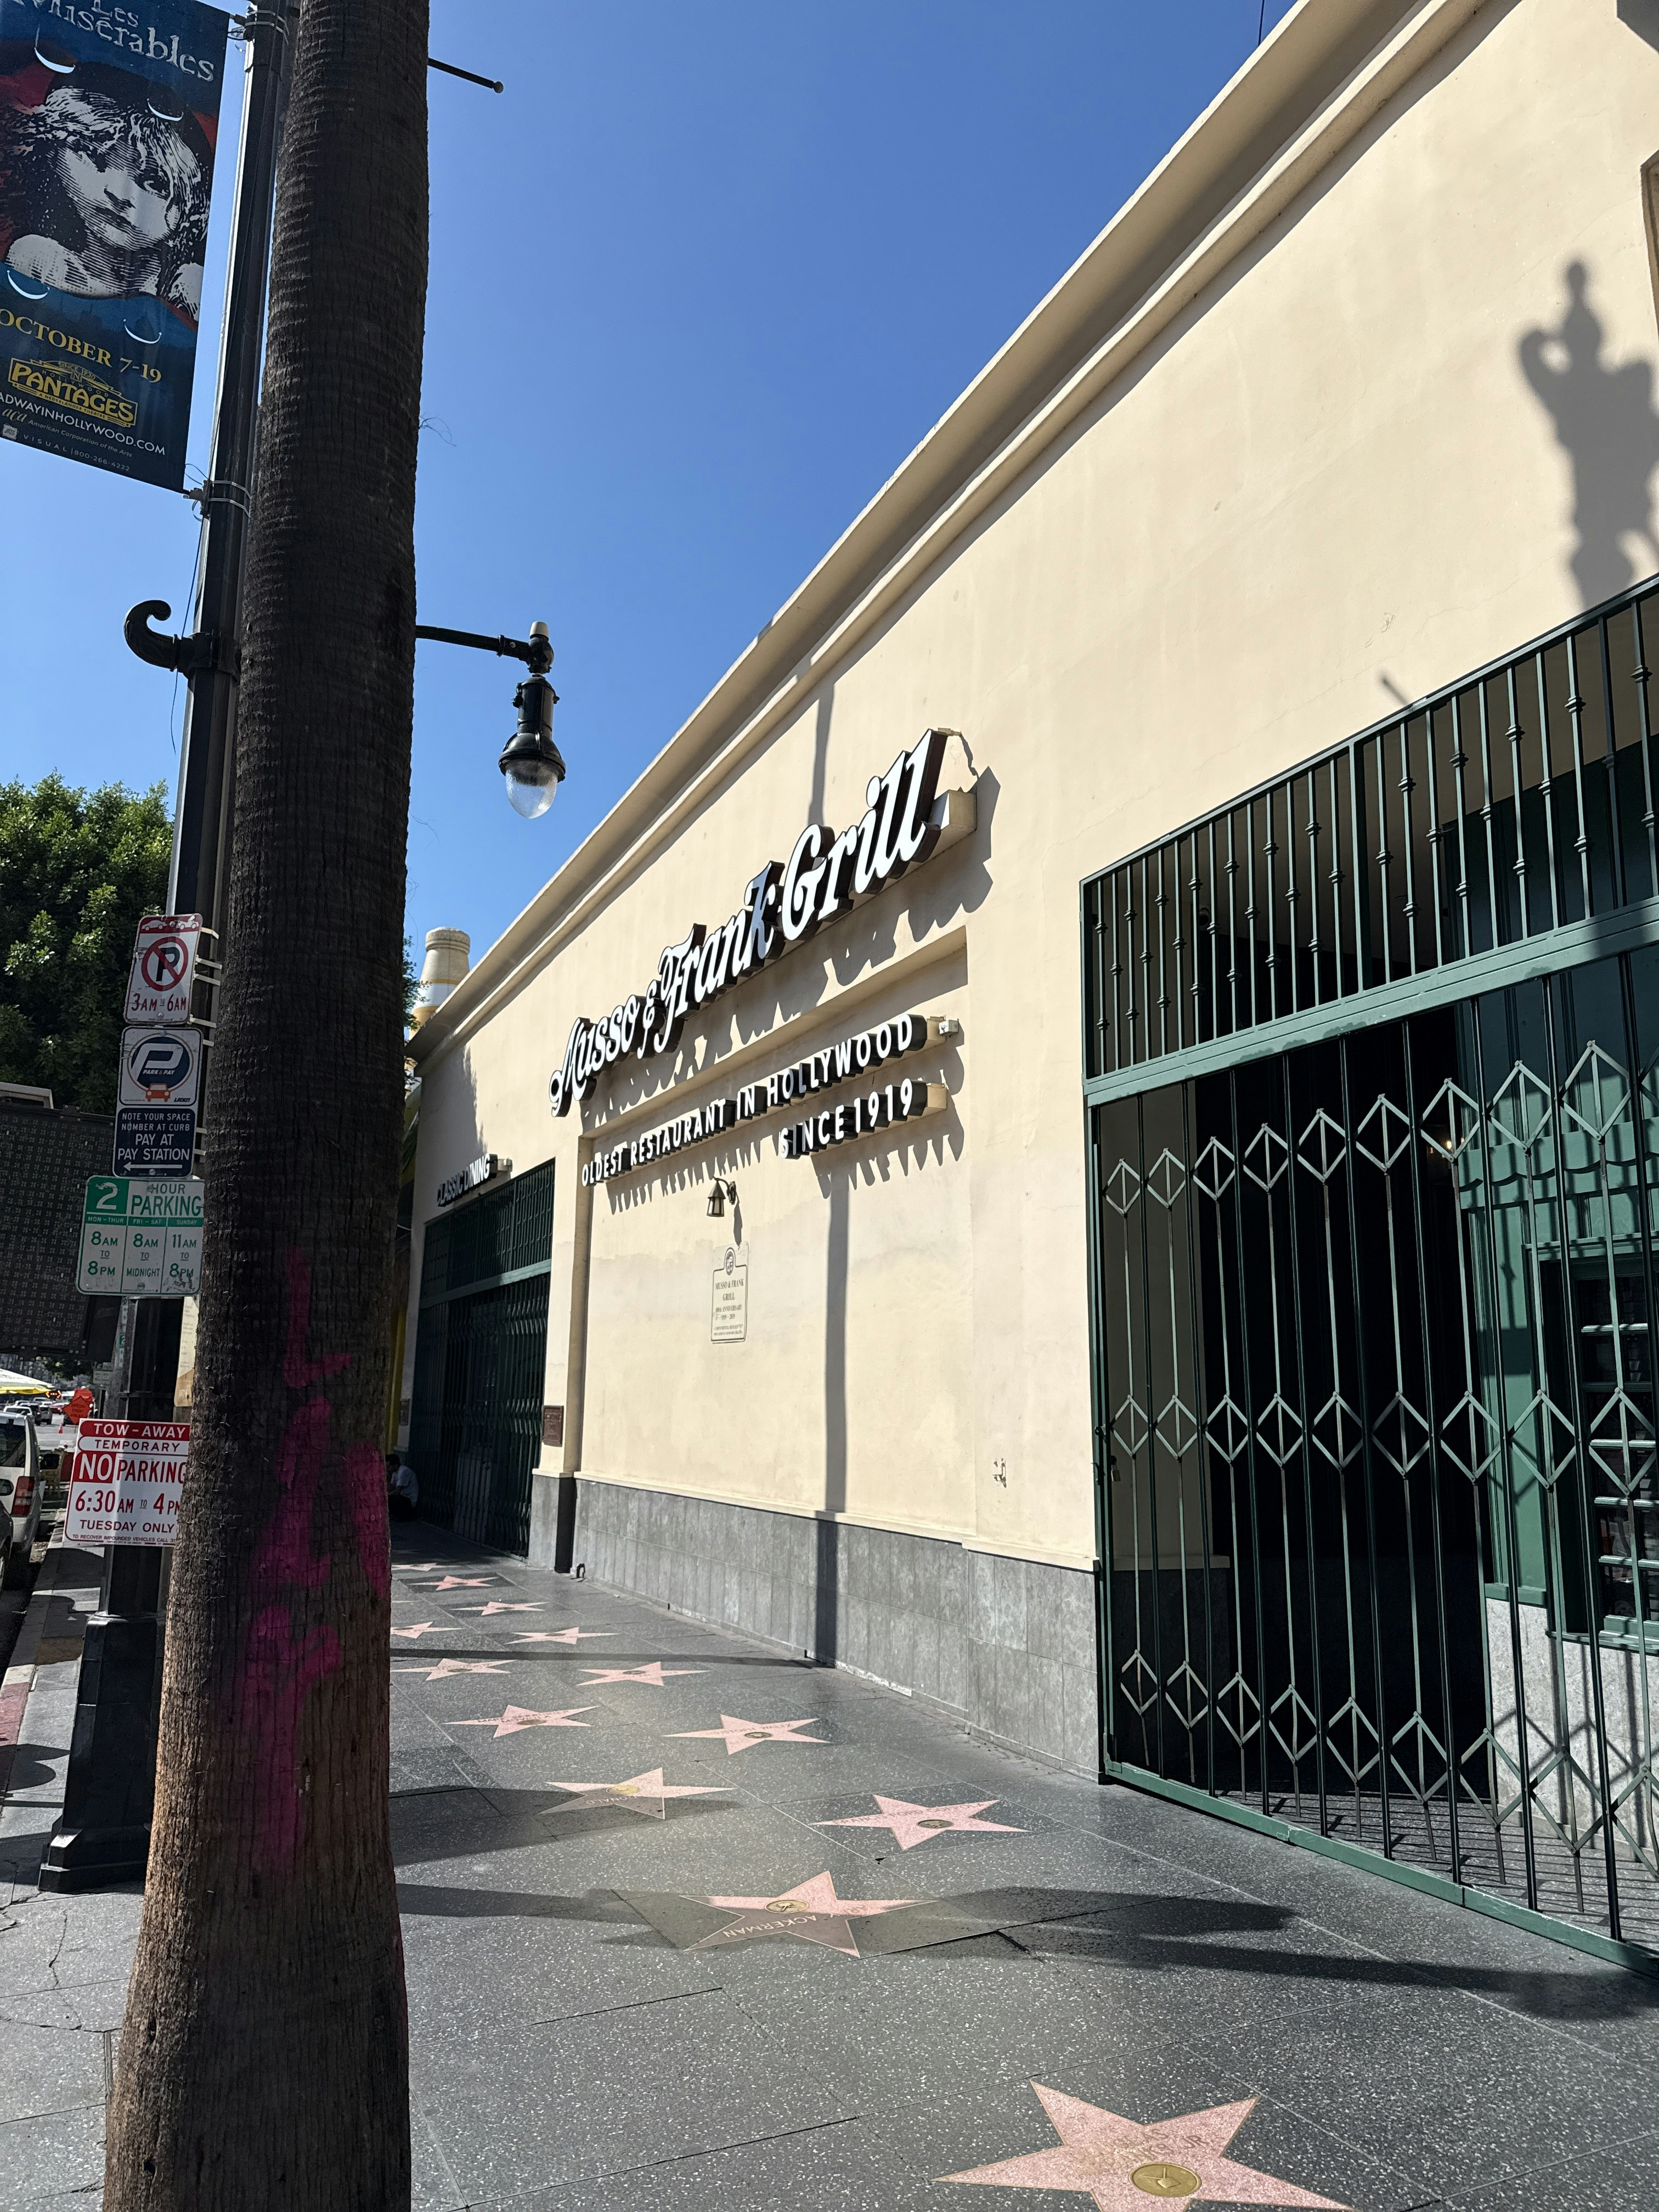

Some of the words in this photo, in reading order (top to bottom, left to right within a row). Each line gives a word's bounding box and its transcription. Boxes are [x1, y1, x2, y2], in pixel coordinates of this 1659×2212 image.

[0, 308, 112, 368] OCTOBER
[119, 357, 162, 383] 7-19
[12, 363, 134, 422] PANTAGES
[24, 434, 67, 452] VISUAL
[29, 419, 59, 434] American
[61, 430, 99, 447] Corporation
[119, 449, 132, 458] Arts
[549, 995, 640, 1118] Musso
[653, 861, 777, 1053] Frank
[781, 729, 933, 941] Grill
[131, 993, 157, 1012] 3AM
[167, 994, 187, 1012] 6AM
[582, 1146, 624, 1187] OLDEST
[630, 1098, 726, 1166] RESTAURANT
[737, 1087, 755, 1120] IN
[767, 1013, 913, 1107] HOLLYWOOD
[144, 1113, 164, 1121] YOUR
[780, 1104, 845, 1159] SINCE
[854, 1077, 913, 1130] 1919
[135, 1133, 156, 1146] PAY
[160, 1133, 174, 1146] AT
[117, 1148, 138, 1160] PAY
[143, 1148, 190, 1160] STATION
[464, 1153, 490, 1192] DINING
[95, 1181, 119, 1210] 2
[150, 1183, 185, 1194] HOUR
[131, 1194, 202, 1216] PARKING
[91, 1231, 118, 1246] 8AM
[133, 1233, 158, 1248] 8AM
[126, 1268, 160, 1277] MIDNIGHT
[723, 1293, 735, 1301] GRILL
[95, 1439, 180, 1452] TEMPORARY
[78, 1453, 113, 1481] NO
[80, 1520, 137, 1532] TUESDAY
[143, 1522, 174, 1533] ONLY
[888, 1809, 924, 1818] FORD
[723, 1914, 817, 1938] ACKERMAN
